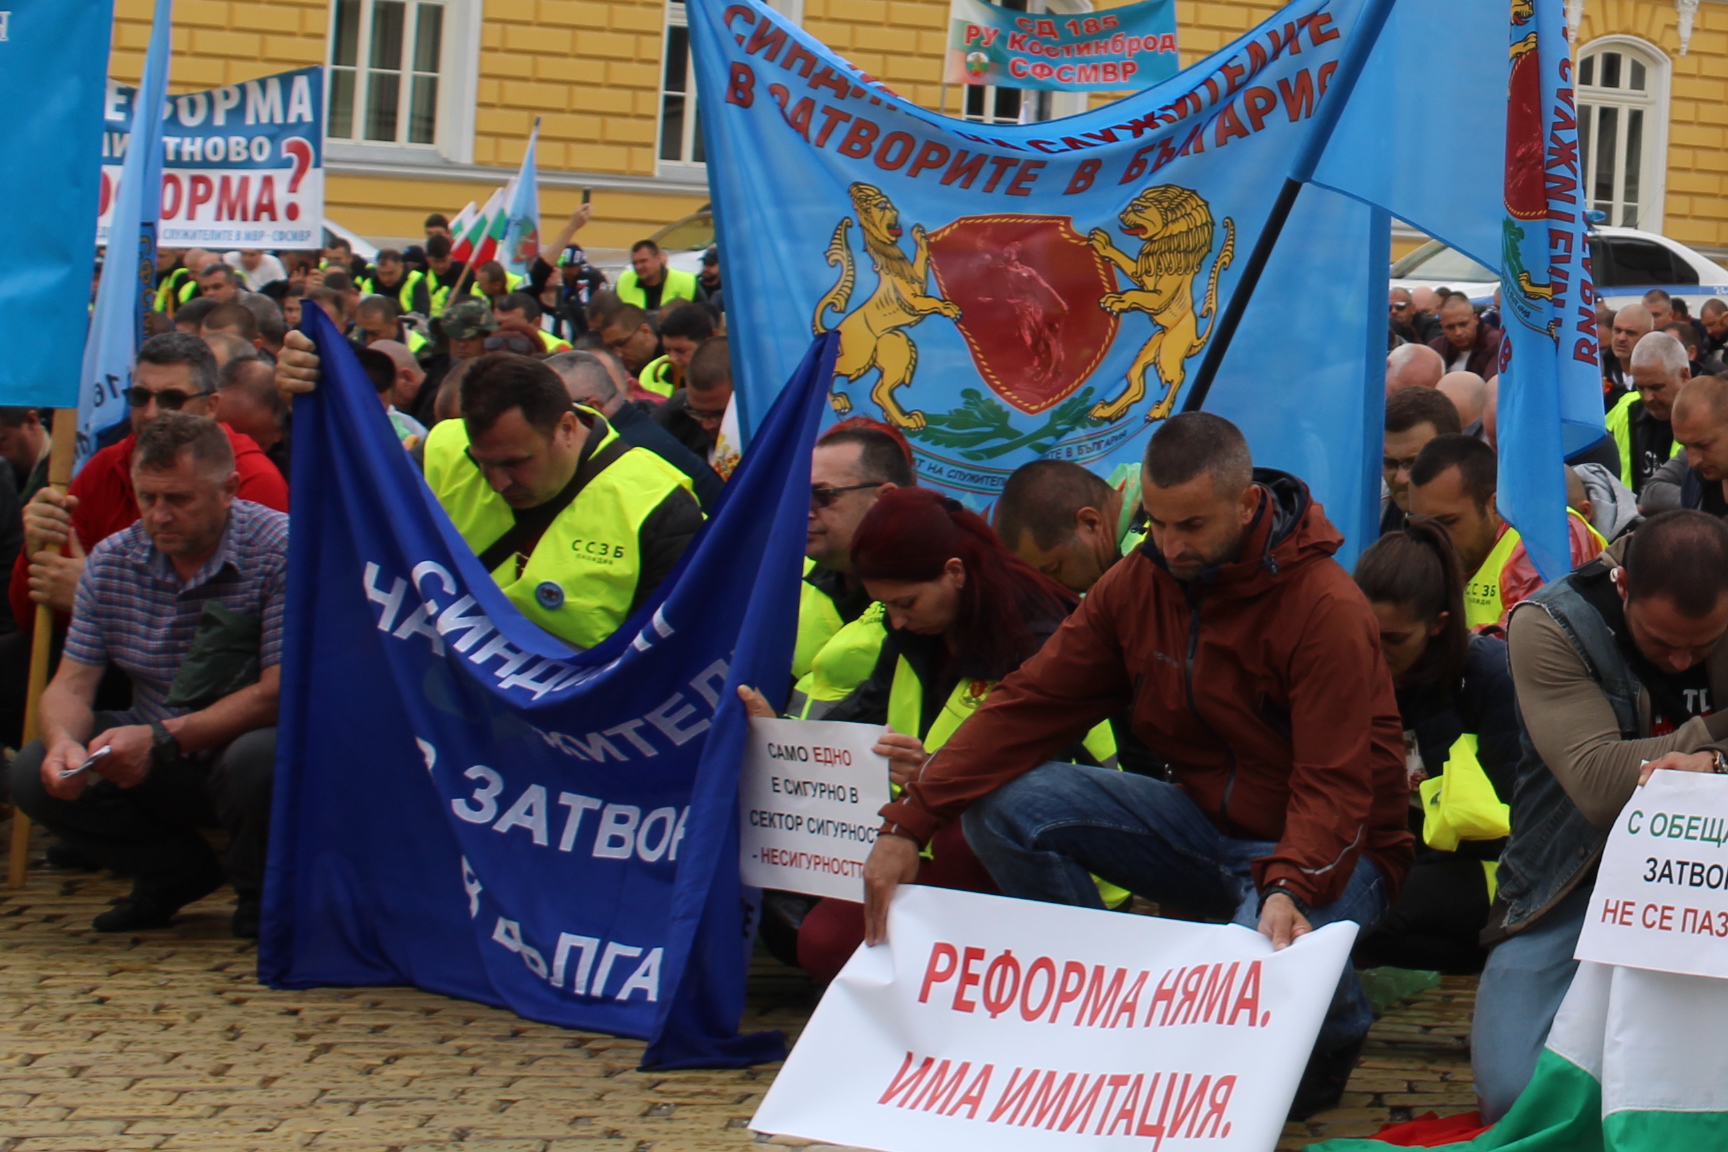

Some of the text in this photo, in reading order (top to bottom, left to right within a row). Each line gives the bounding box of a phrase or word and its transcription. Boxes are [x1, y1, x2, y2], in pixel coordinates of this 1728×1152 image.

[964, 24, 1177, 58] РУ Костинброд
[1015, 15, 1120, 39] СД 185
[1008, 57, 1138, 83] СФСМВР
[725, 61, 756, 109] В
[1062, 158, 1103, 195] В
[767, 742, 852, 767] САМО ЕДНО
[771, 776, 859, 804] Е СИГУРНО В
[750, 809, 803, 831] СЕКТОР
[1627, 810, 1644, 836] С
[760, 847, 866, 879] НЕСИГУРНОСТТ
[1600, 899, 1636, 927] НЕ
[1641, 903, 1676, 932] СЕ
[917, 940, 1273, 1030] РЕФОРМА НЯМА.
[877, 1051, 1238, 1152] ИМА ИМИТАЦИЯ.
